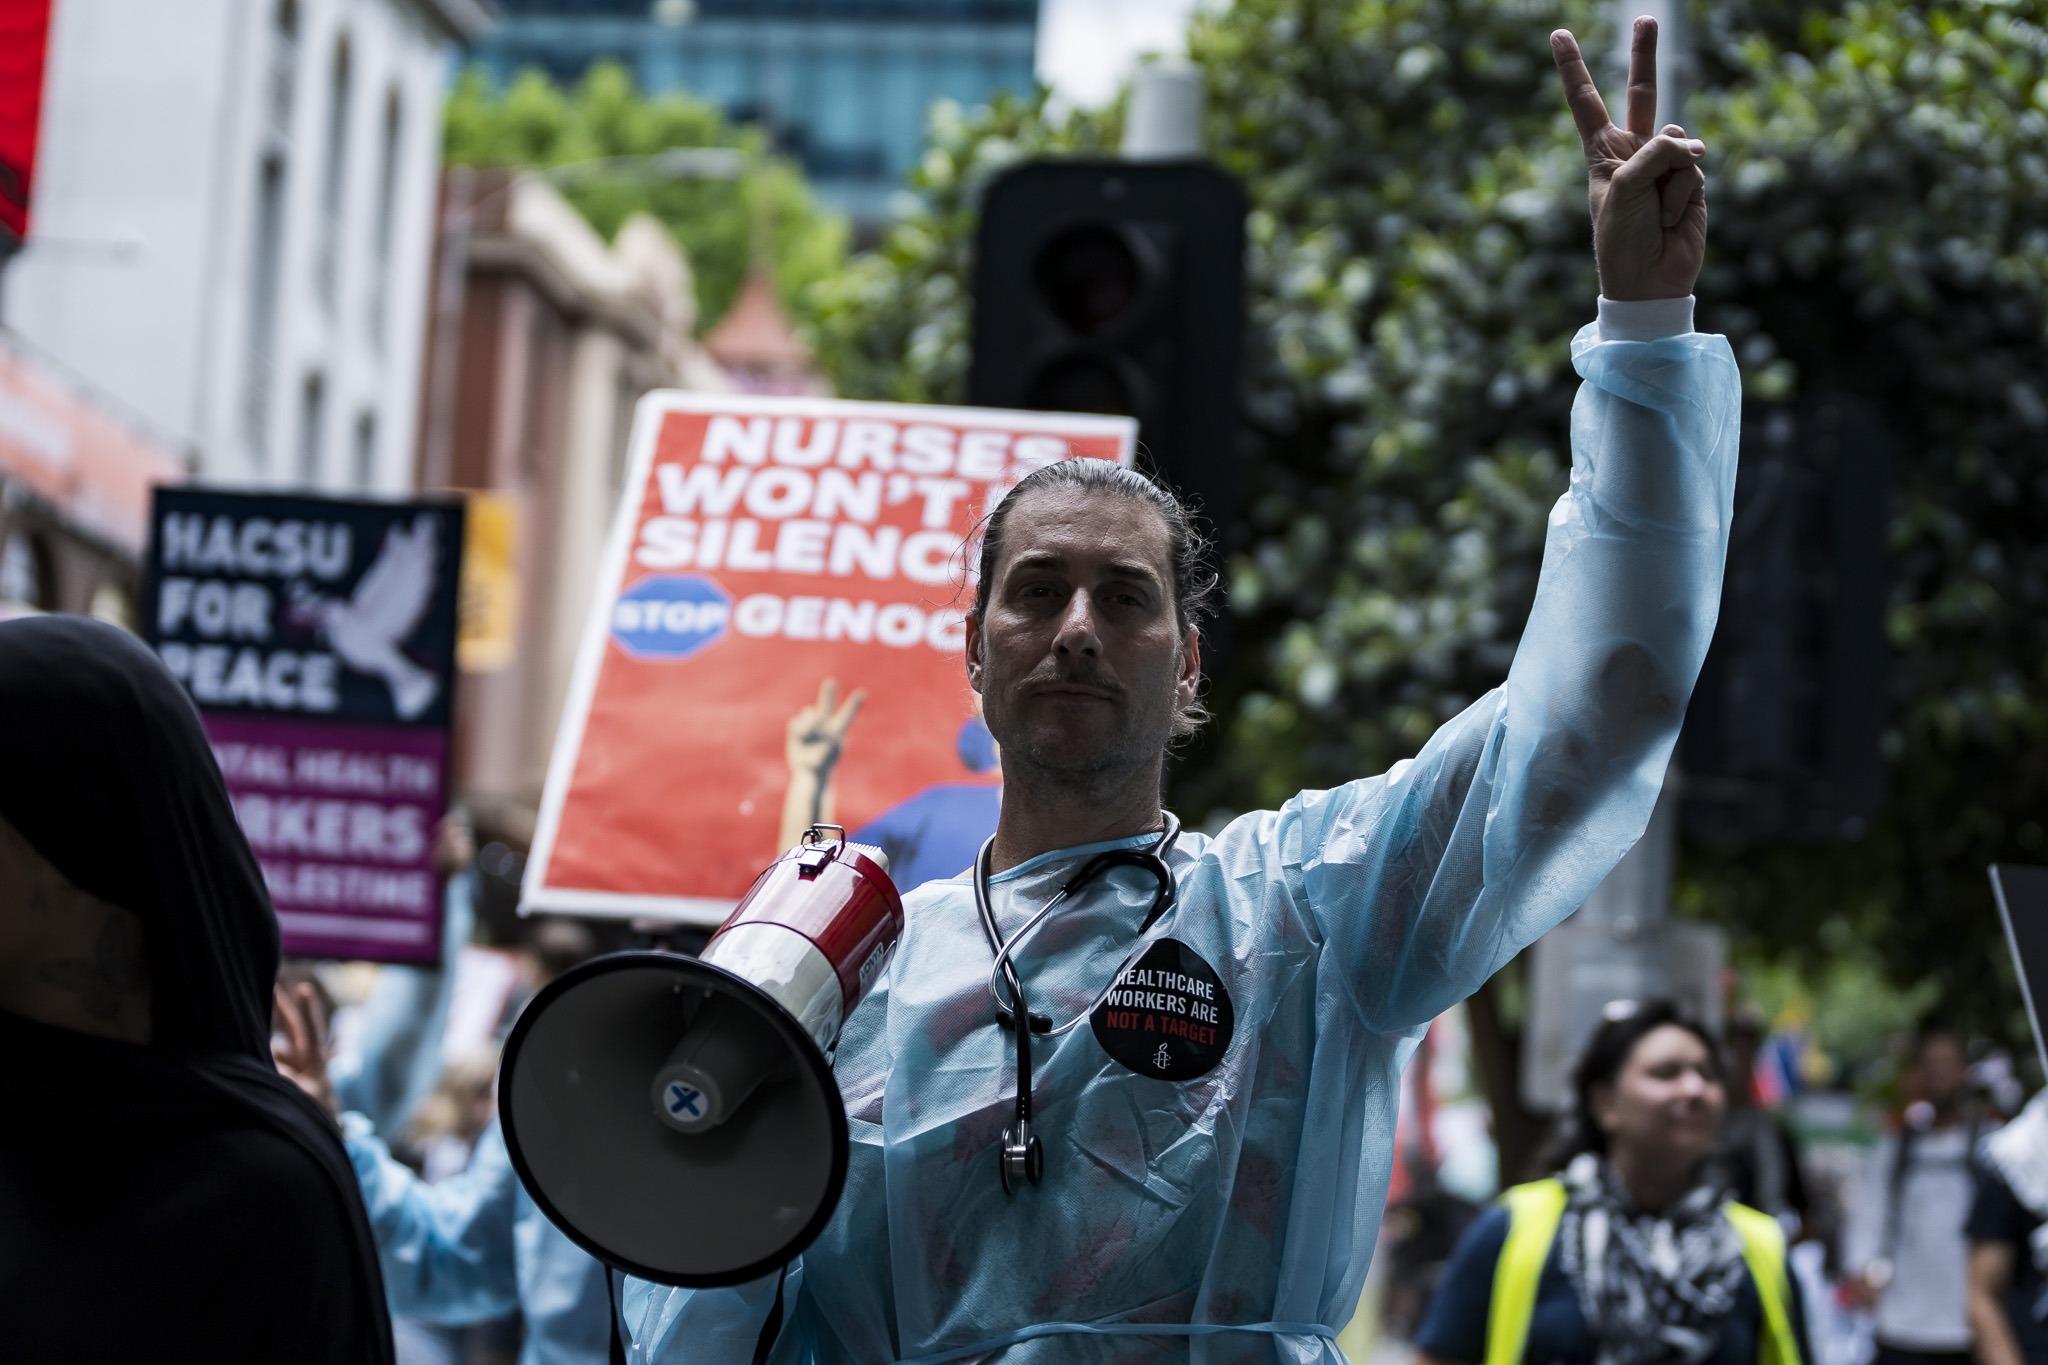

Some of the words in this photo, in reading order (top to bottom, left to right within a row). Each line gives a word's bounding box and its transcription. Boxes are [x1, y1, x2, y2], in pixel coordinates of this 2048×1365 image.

[702, 416, 1067, 481] NURSES
[656, 463, 970, 528] WON'T
[163, 511, 351, 580] HACSU
[636, 515, 979, 586] SILENC
[158, 576, 271, 642] FOR
[613, 600, 730, 635] STOP
[158, 642, 341, 713] PEACE
[296, 748, 436, 796] HEALTH
[233, 794, 425, 864] RKERS
[262, 861, 430, 913] LESTINE
[1107, 989, 1187, 1015] WORKERS
[1190, 1001, 1218, 1024] ARE
[1117, 969, 1214, 1000] HEALTHCARE
[1107, 1011, 1140, 1030] NOT
[1144, 1014, 1155, 1032] A
[1160, 1016, 1217, 1045] TARGET
